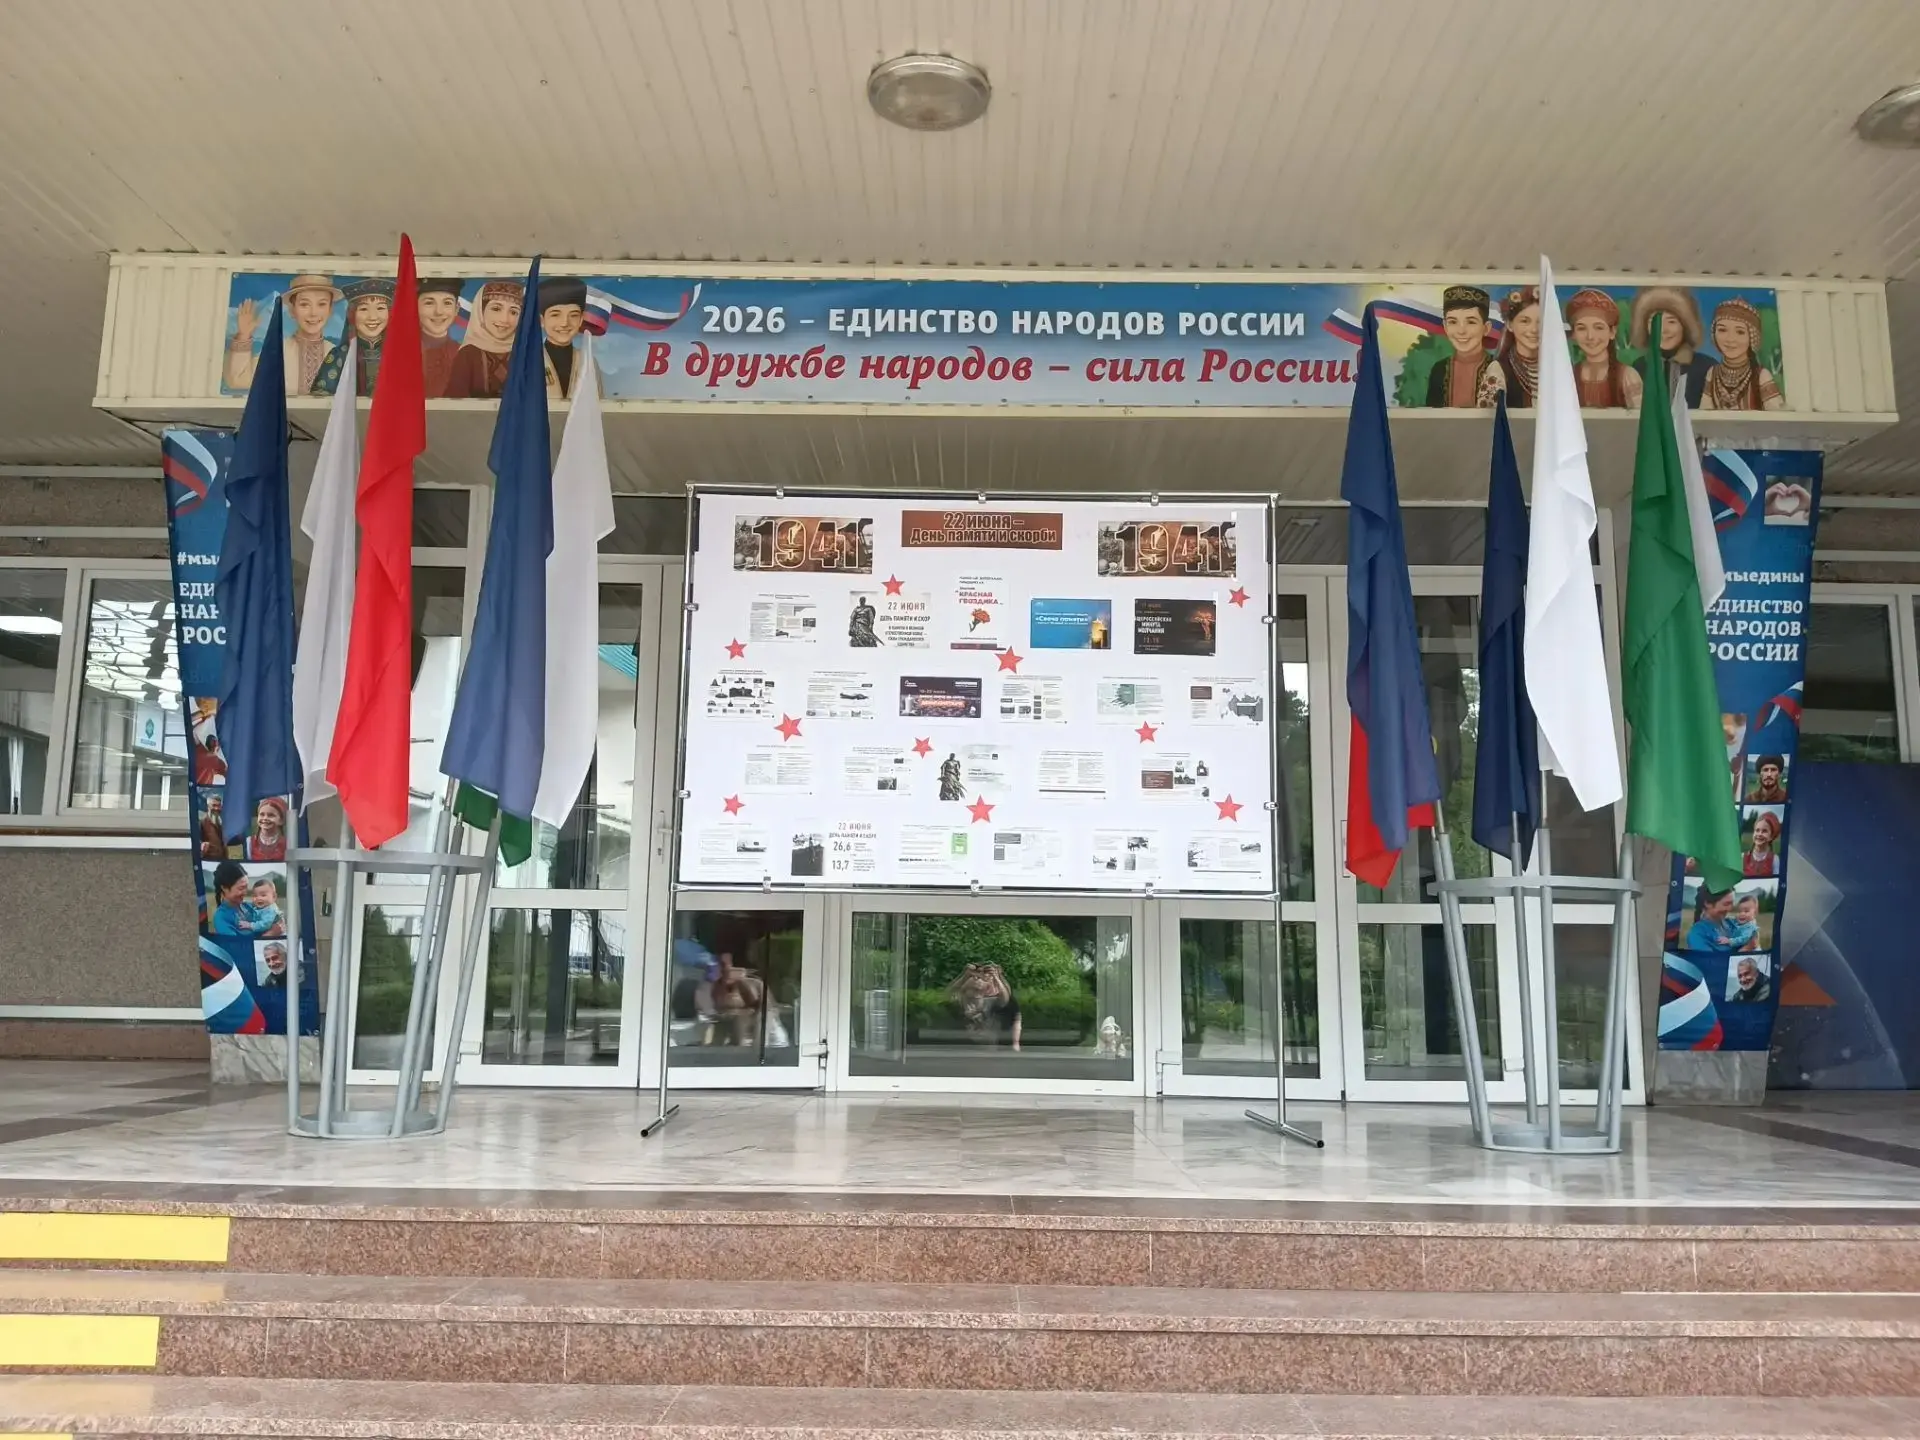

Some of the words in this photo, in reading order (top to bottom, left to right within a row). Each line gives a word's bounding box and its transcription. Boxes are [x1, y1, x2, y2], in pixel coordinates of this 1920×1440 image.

[702, 304, 786, 334] 2026
[828, 307, 998, 338] ЕДИНСТВО
[1012, 310, 1165, 340] НАРОДОВ
[1179, 311, 1305, 337] РОССИИ
[640, 341, 672, 376] В
[685, 340, 846, 389] дружбе
[859, 345, 1033, 390] народов
[1086, 356, 1186, 383] сила
[943, 512, 965, 530] 22
[966, 514, 1012, 530] июня
[752, 520, 859, 569] 1941
[910, 528, 946, 545] День
[946, 530, 996, 543] памяти
[997, 530, 1008, 543] и
[1008, 528, 1057, 544] скорби
[1115, 524, 1223, 573] 1941
[887, 601, 898, 611] 22
[900, 601, 926, 611] ИЮНЯ
[182, 626, 227, 646] РОС
[1705, 619, 1802, 640] НАРОДОВ
[838, 822, 847, 831] 22
[833, 841, 851, 852] 26,6
[832, 860, 850, 871] 13,7
